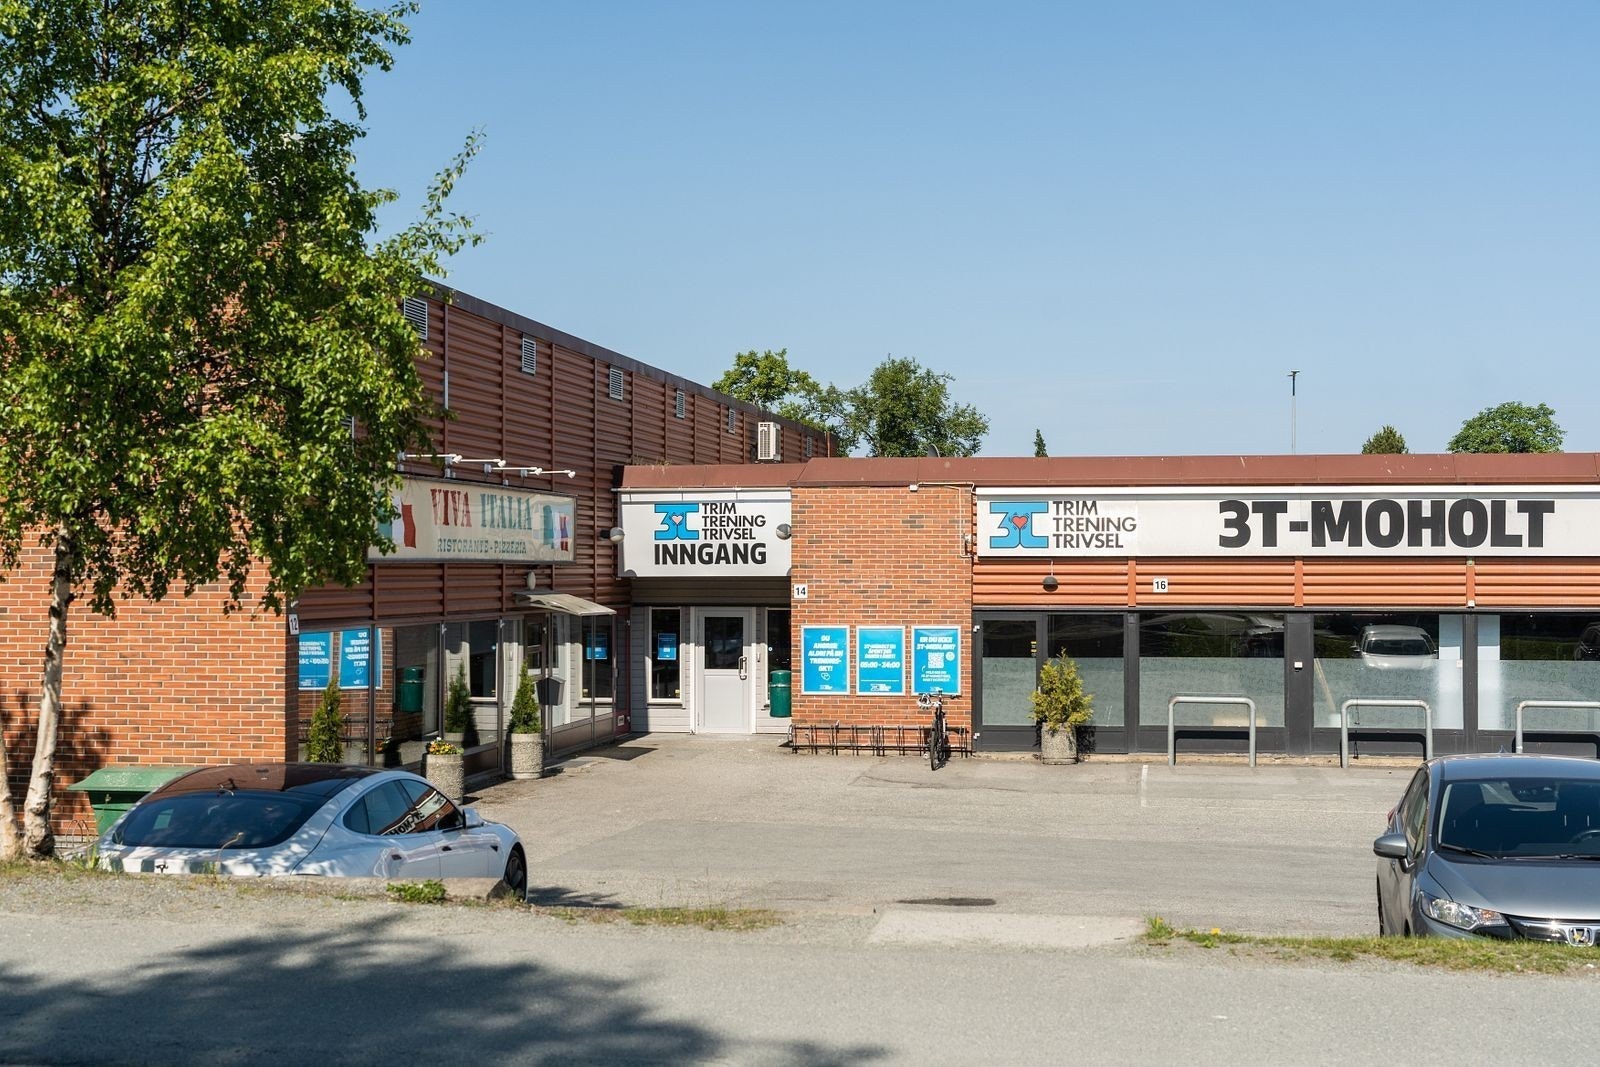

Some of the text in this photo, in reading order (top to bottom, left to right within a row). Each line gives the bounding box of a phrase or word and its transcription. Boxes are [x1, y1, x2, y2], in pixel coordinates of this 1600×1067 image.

[430, 488, 472, 528] VIVA
[702, 502, 737, 515] TRIM
[1053, 500, 1098, 516] TRIM
[702, 515, 767, 528] TRENING
[1053, 516, 1137, 533] TRENING
[1218, 499, 1556, 549] 3T-MOHOLT
[702, 528, 756, 541] TRIVSEL
[1053, 533, 1124, 549] TRIVSEL
[654, 542, 767, 565] INNGANG
[795, 585, 807, 597] 14
[1154, 579, 1167, 591] 16
[290, 618, 299, 631] 12
